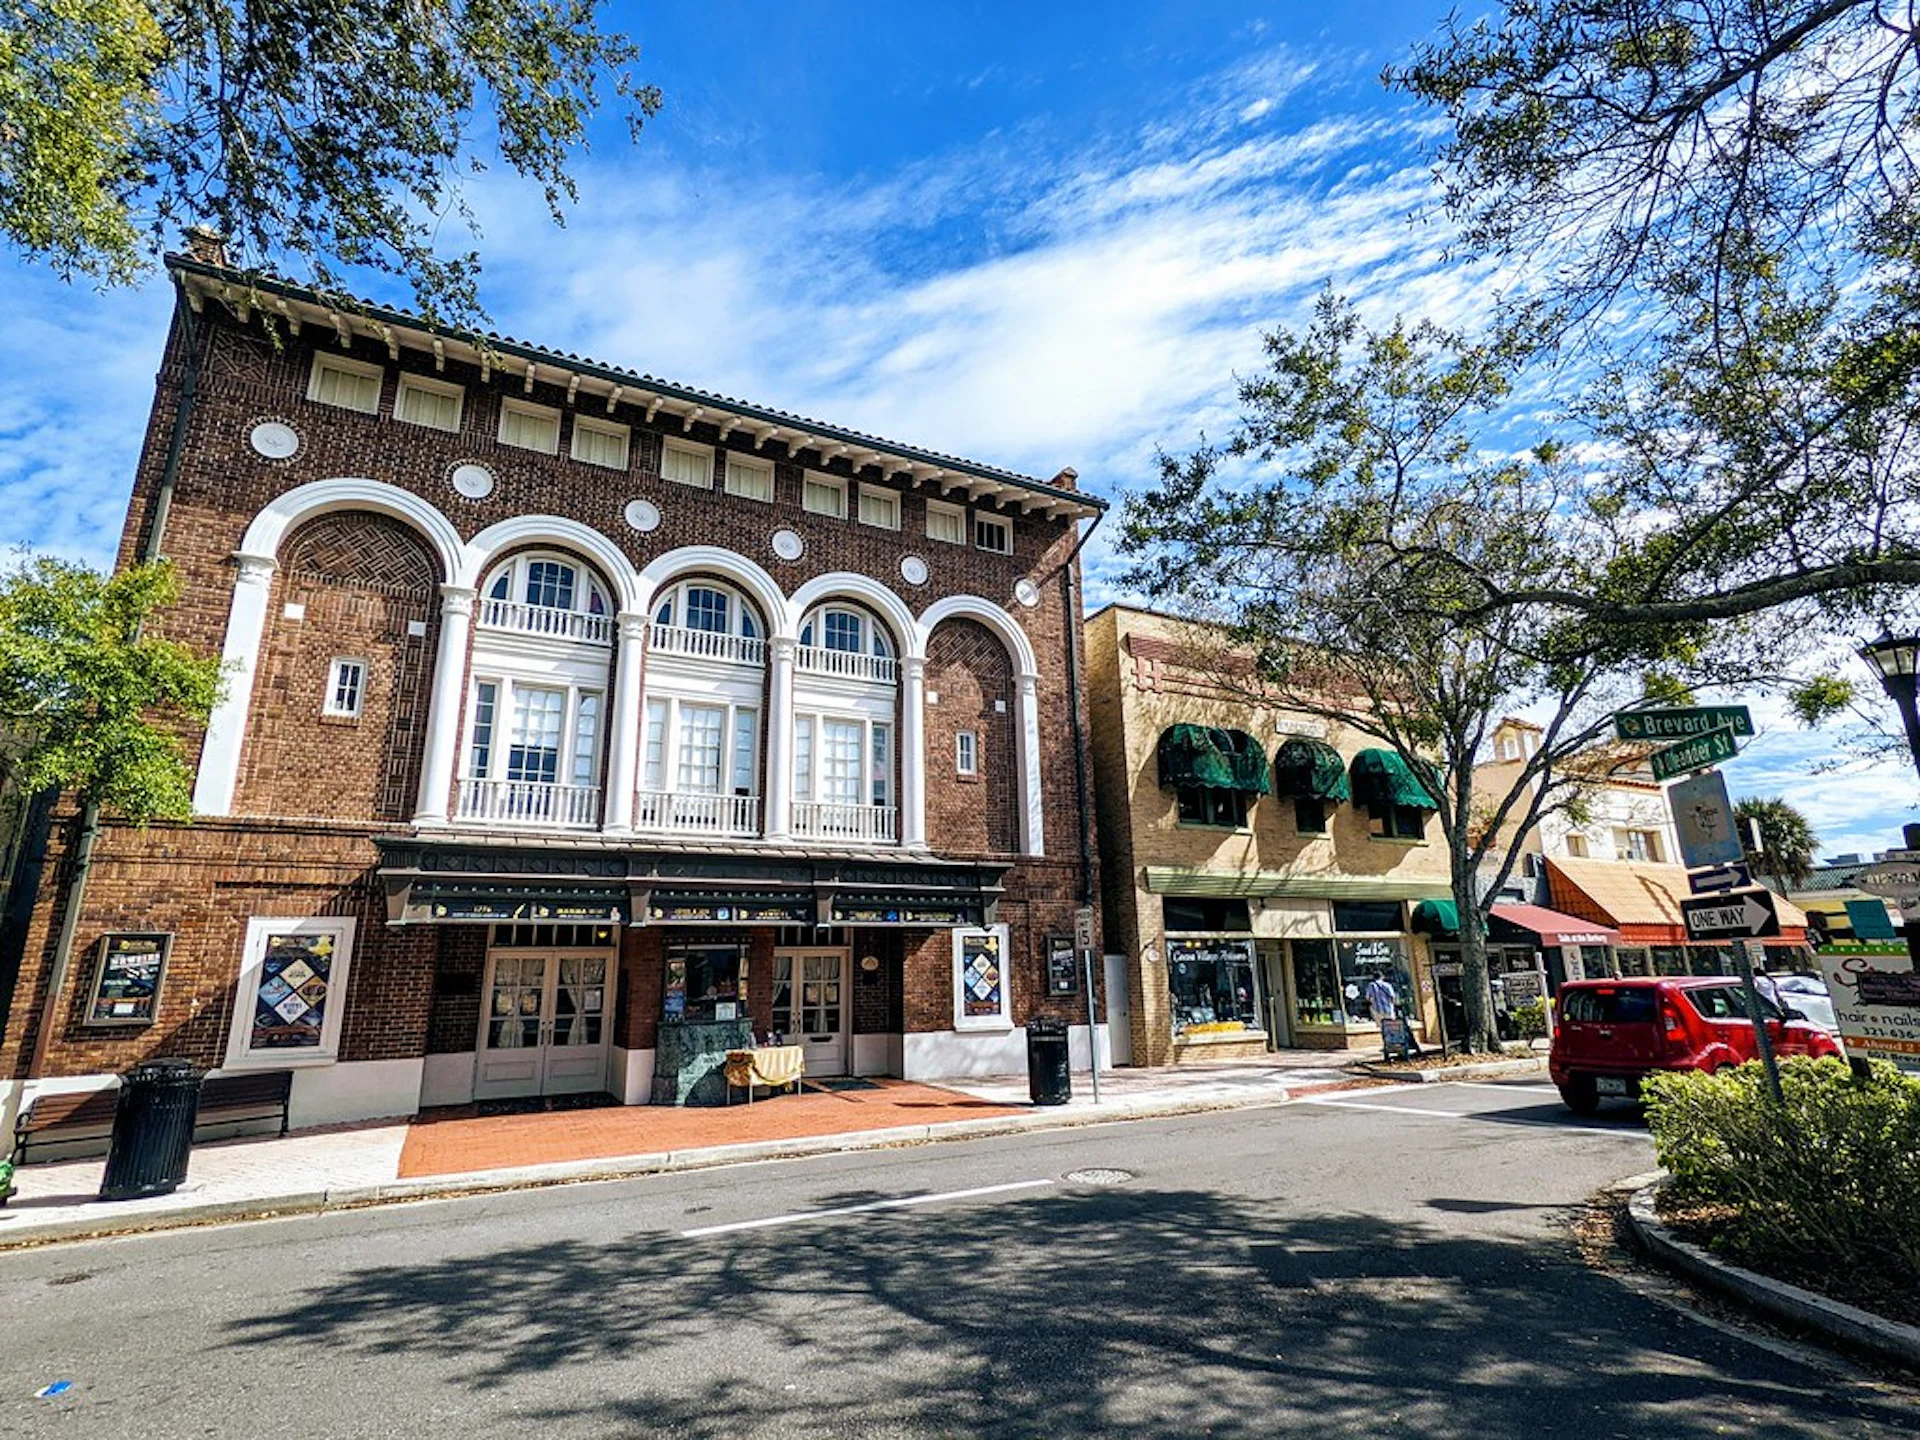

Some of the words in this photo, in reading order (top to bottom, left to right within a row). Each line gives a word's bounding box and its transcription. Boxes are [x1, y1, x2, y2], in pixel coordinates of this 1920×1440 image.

[1644, 714, 1709, 735] Brevard
[1717, 712, 1745, 732] Ave
[1713, 734, 1731, 756] St
[1691, 911, 1717, 928] ONE
[1718, 907, 1745, 926] WAY
[1078, 930, 1090, 945] 15
[1836, 1009, 1867, 1022] hair
